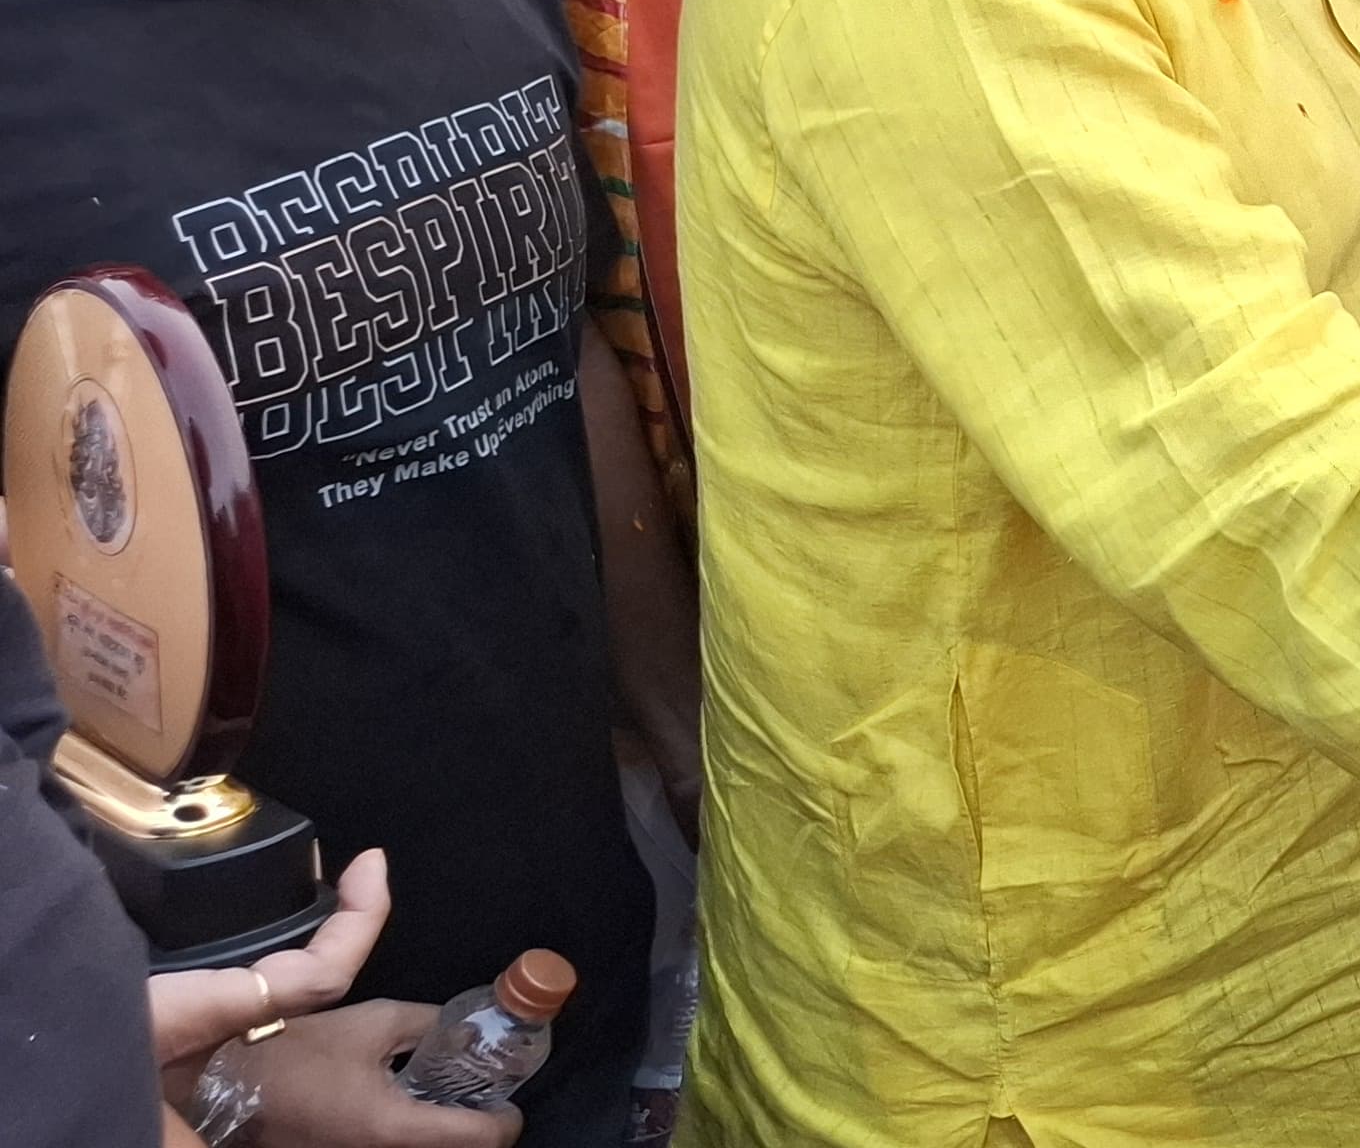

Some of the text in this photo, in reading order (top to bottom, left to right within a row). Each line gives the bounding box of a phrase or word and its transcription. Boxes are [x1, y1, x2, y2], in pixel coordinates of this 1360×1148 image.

[443, 397, 494, 440] Trust
[514, 360, 560, 397] Atom,
[317, 472, 385, 508] They
[394, 451, 470, 484] Make
